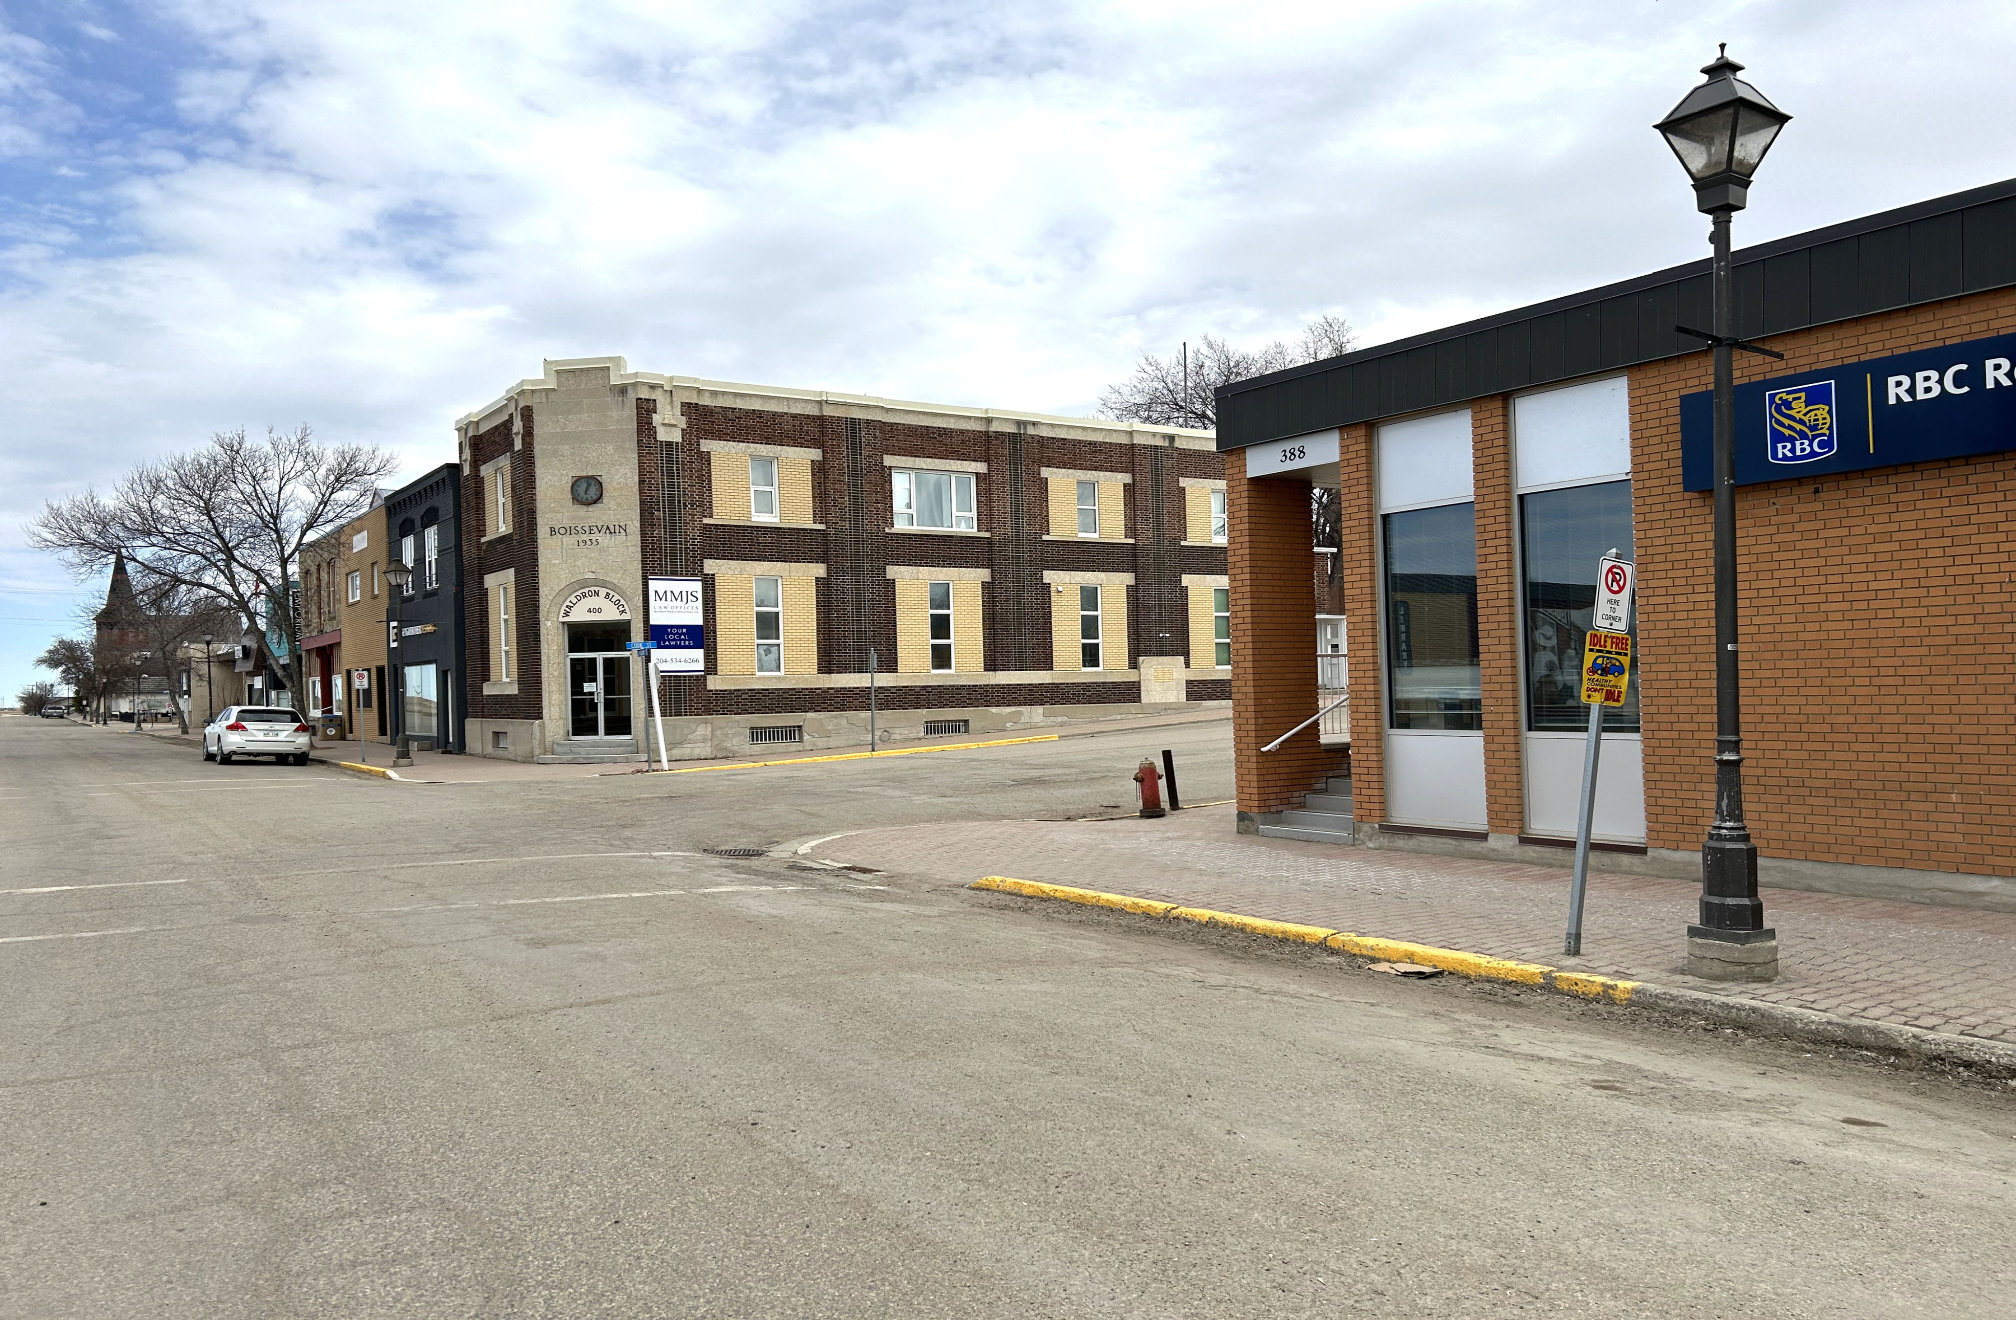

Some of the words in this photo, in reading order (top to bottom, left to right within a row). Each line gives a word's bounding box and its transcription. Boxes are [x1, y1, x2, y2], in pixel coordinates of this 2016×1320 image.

[1887, 363, 1971, 405] RBC
[1985, 358, 2016, 389] R
[1280, 445, 1306, 463] 388
[1777, 436, 1829, 459] RBC
[549, 524, 628, 536] BOISSEVAIN
[576, 538, 600, 547] 1935
[562, 589, 600, 618] WALDRON
[604, 591, 627, 616] BLOCK
[654, 589, 699, 605] MMJS
[1606, 598, 1620, 606] HERE
[1601, 613, 1622, 623] CORNER
[1609, 606, 1617, 614] TO
[1589, 633, 1608, 649] IDLE
[1610, 636, 1629, 652] FREE
